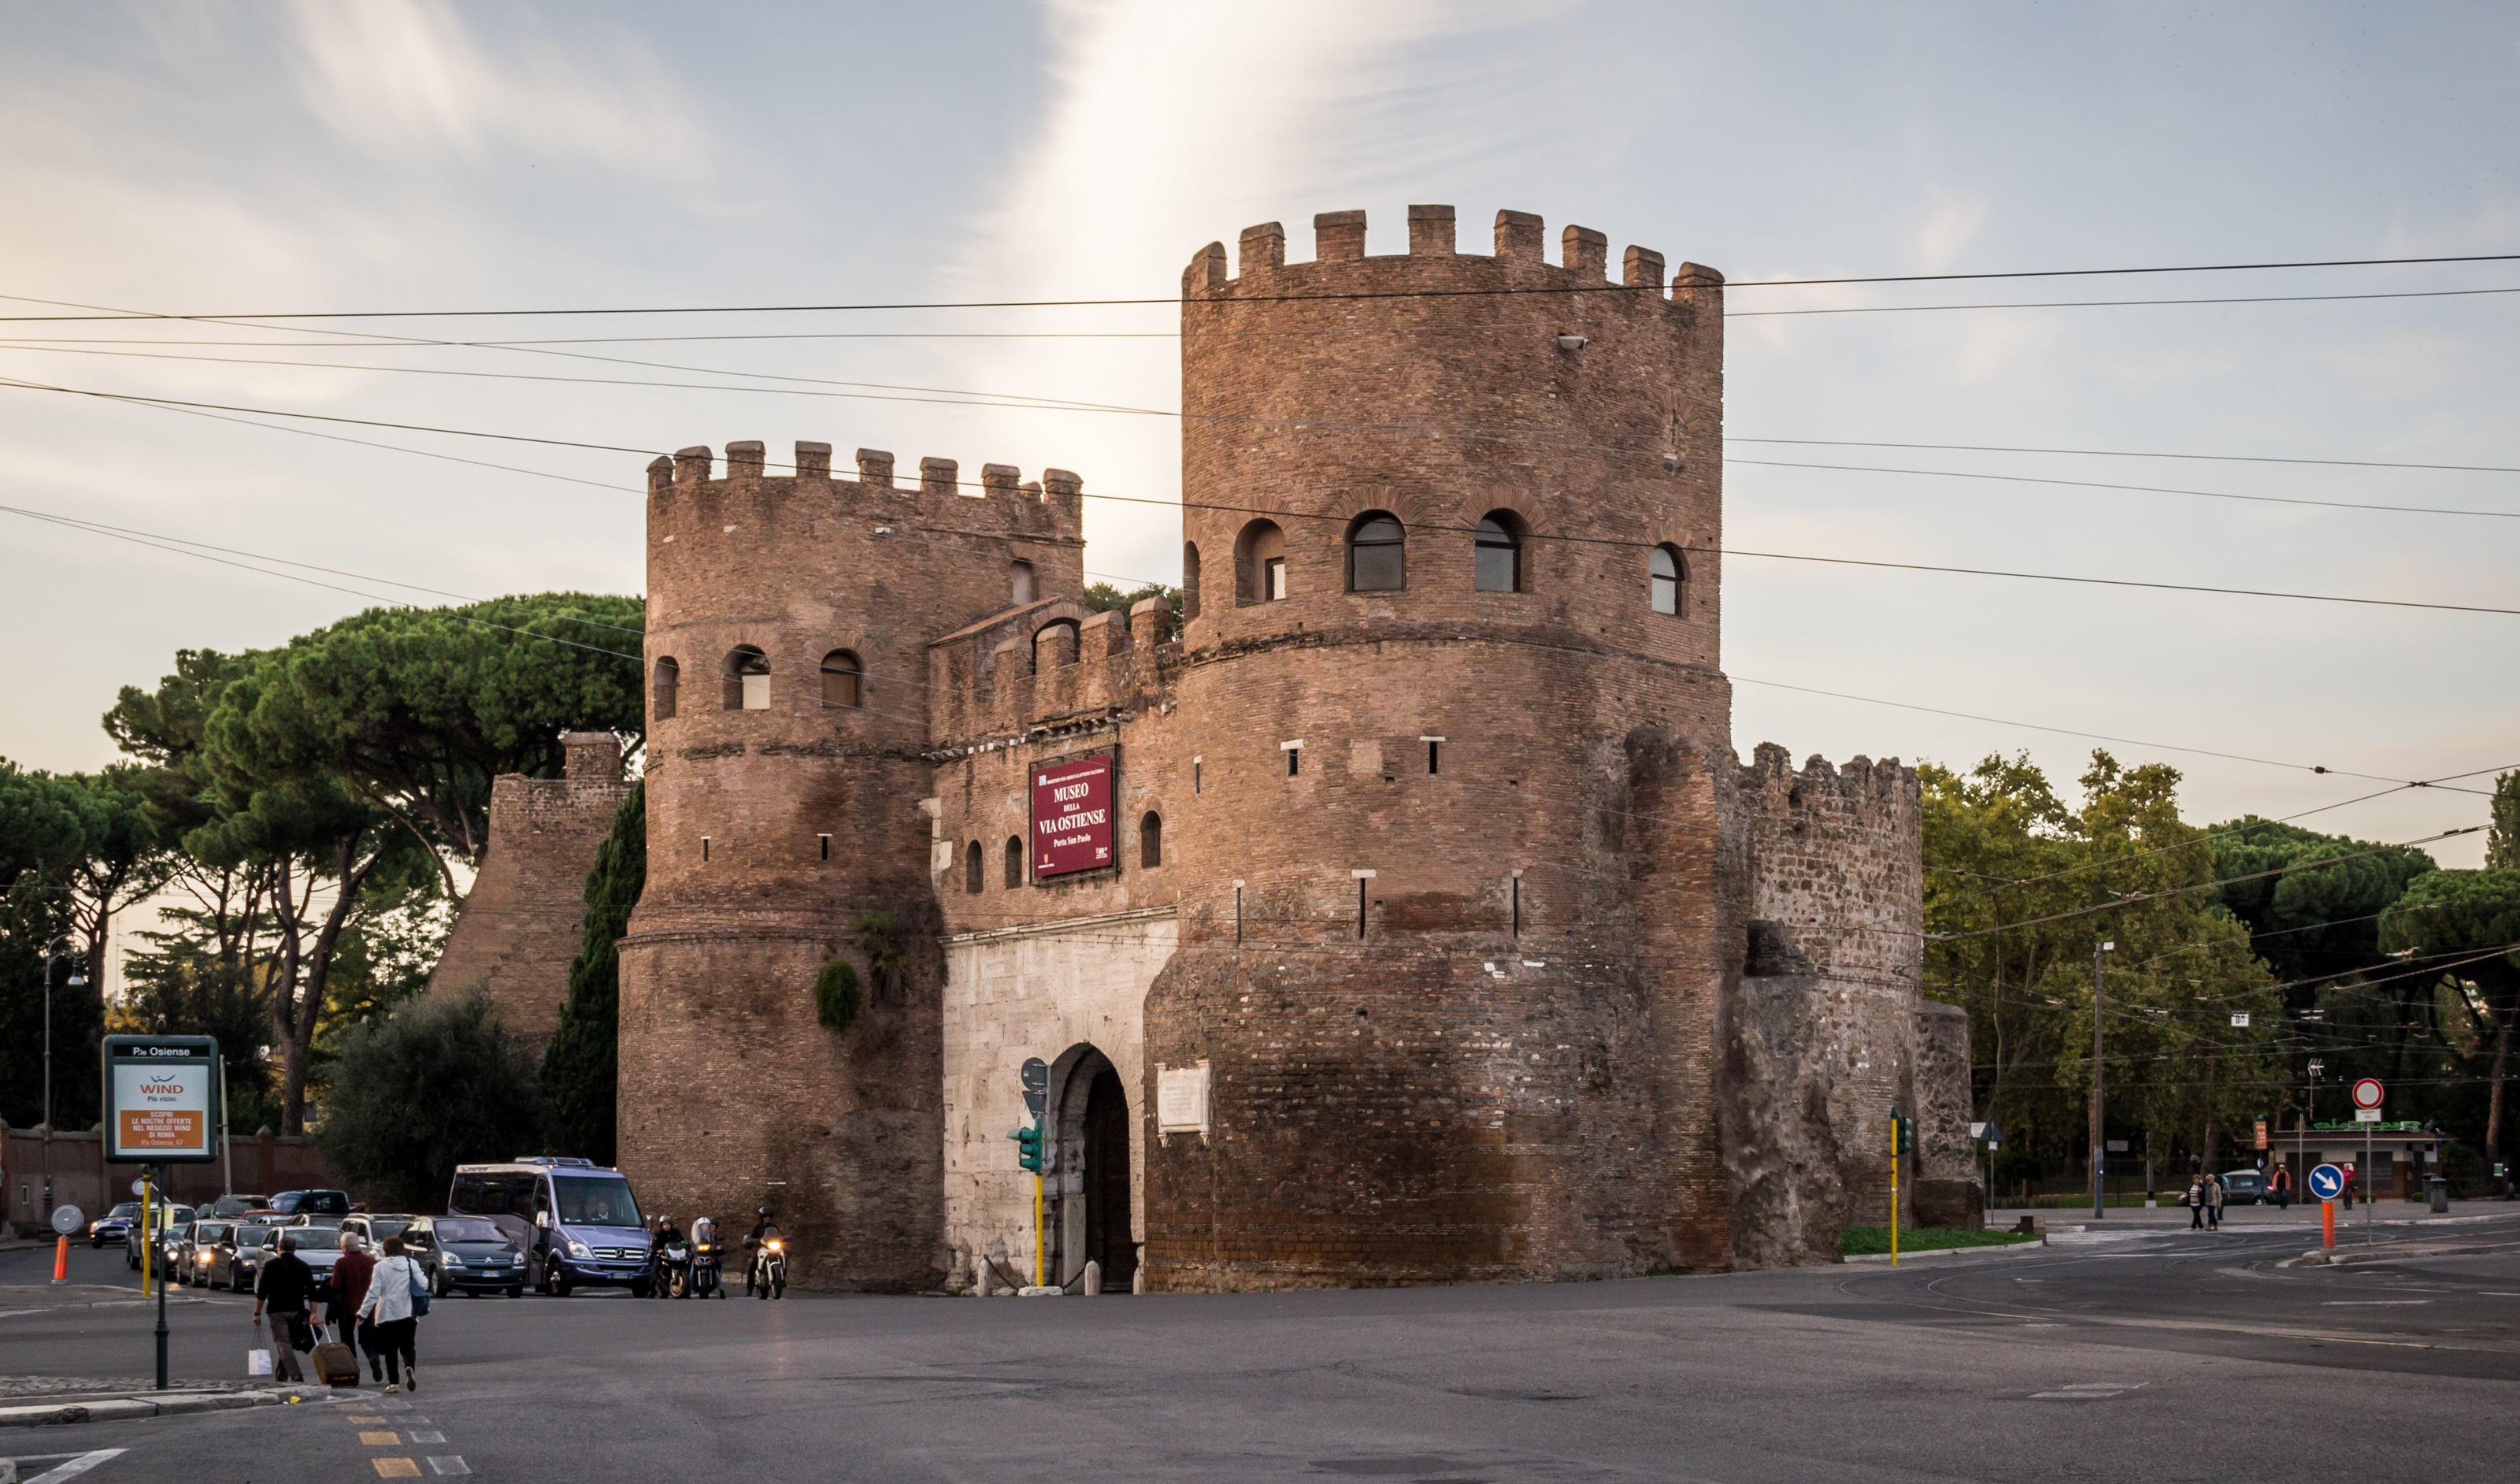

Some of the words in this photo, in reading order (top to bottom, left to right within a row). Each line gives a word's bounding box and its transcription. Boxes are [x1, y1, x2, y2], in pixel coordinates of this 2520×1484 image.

[1054, 782, 1089, 803] MUSEO
[1063, 803, 1080, 812] DELLA
[1040, 819, 1057, 834] VIA
[1058, 809, 1106, 831] OSTIENSE
[1054, 839, 1067, 848] Porta
[1067, 837, 1077, 845] San
[1077, 833, 1091, 843] Paolo
[150, 1047, 191, 1055] Osiense
[140, 1085, 183, 1094] WIND
